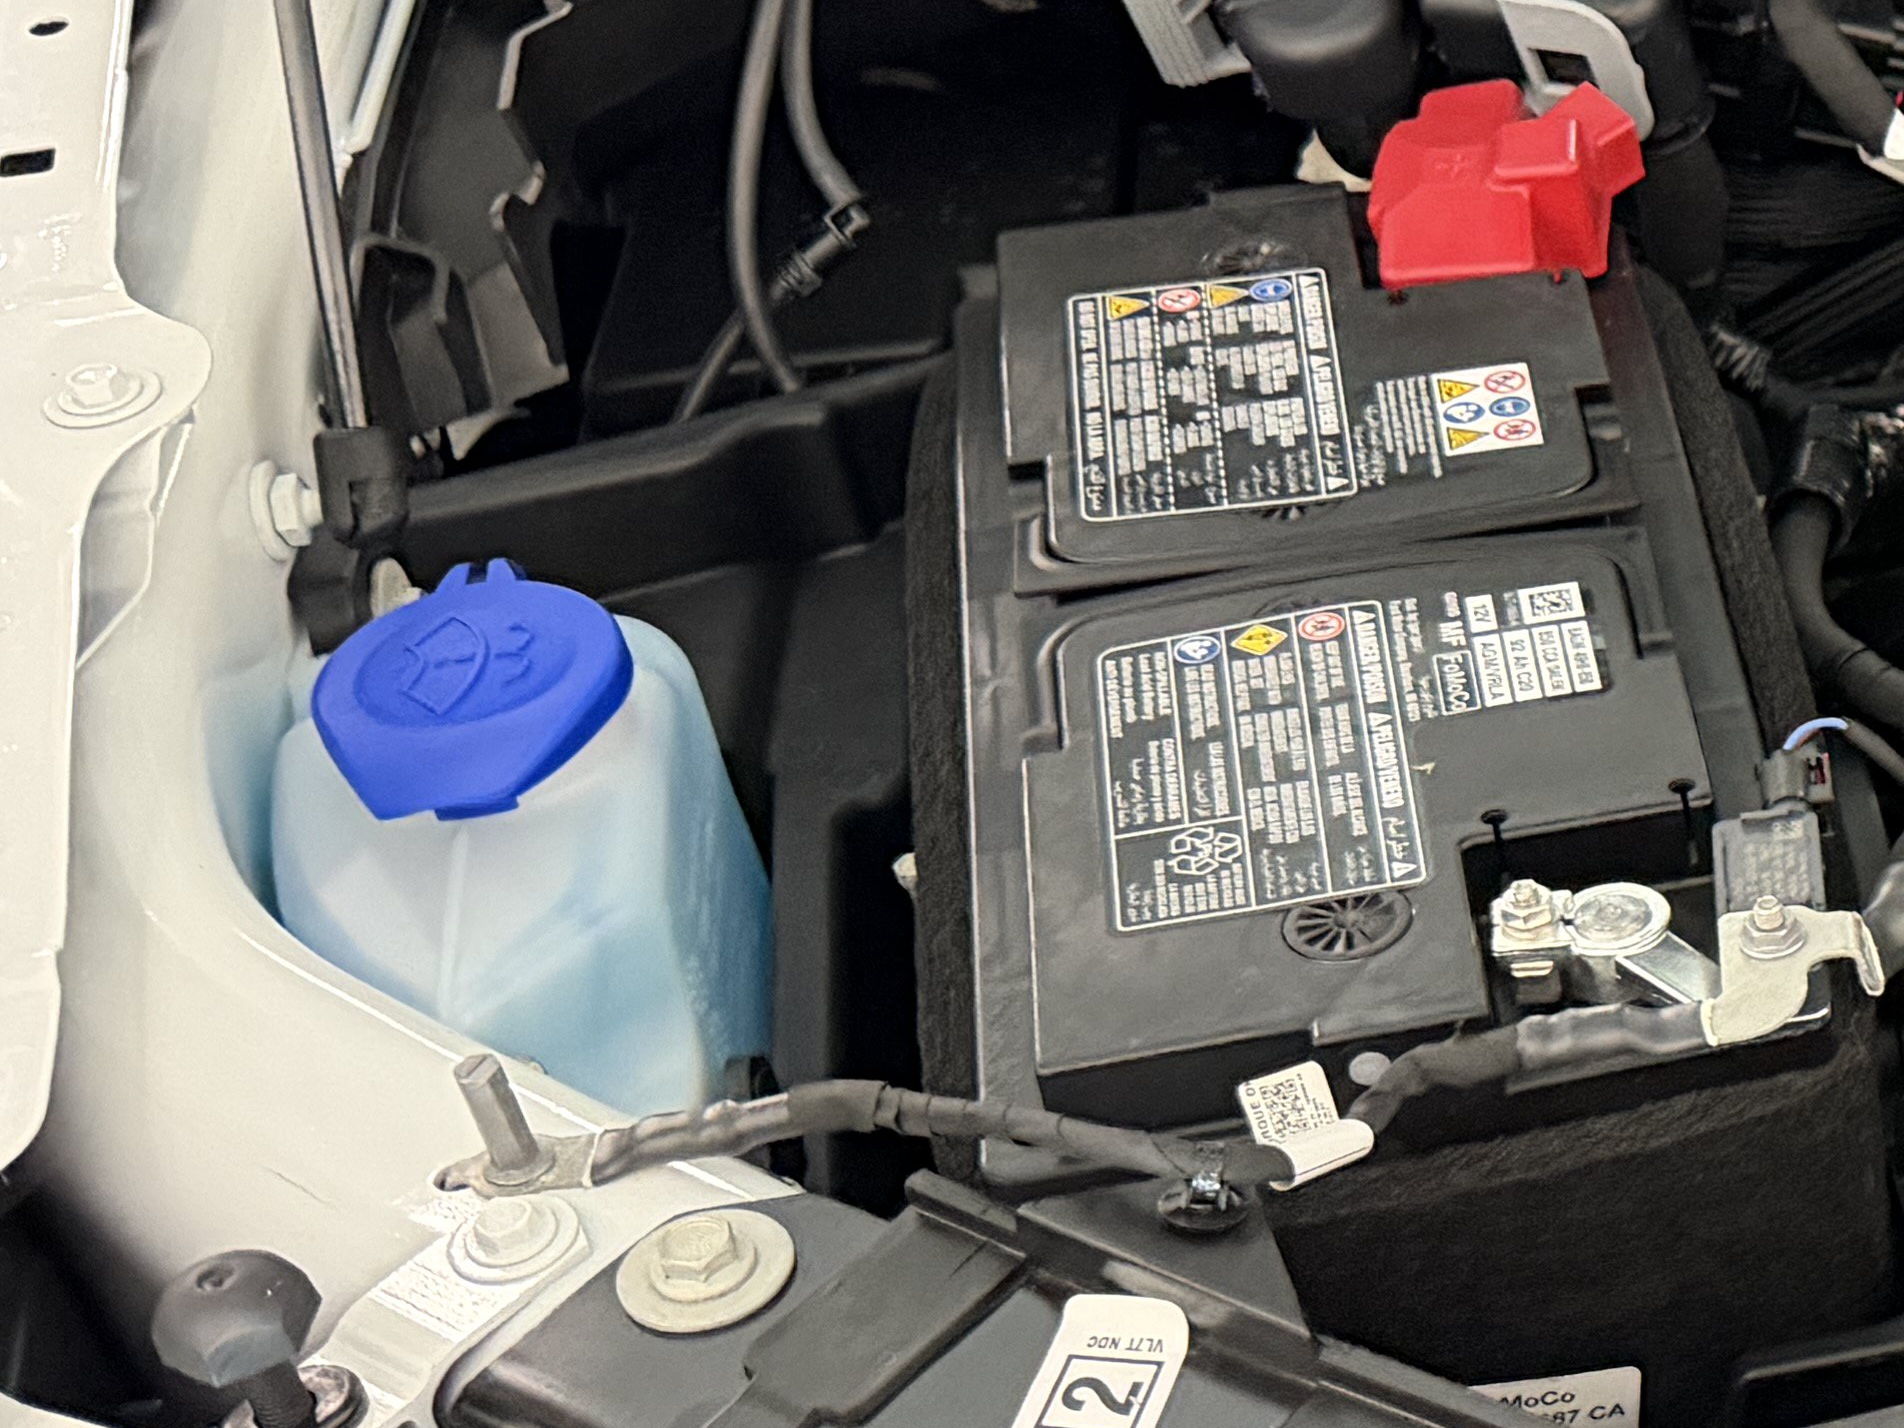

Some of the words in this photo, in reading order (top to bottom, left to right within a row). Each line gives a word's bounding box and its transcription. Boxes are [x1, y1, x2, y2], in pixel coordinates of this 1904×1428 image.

[1441, 653, 1471, 711] FoMoCo
[1086, 1335, 1121, 1351] NDC
[1124, 1336, 1165, 1354] VL7T
[1060, 1375, 1145, 1417] 2
[1588, 1403, 1626, 1421] CA
